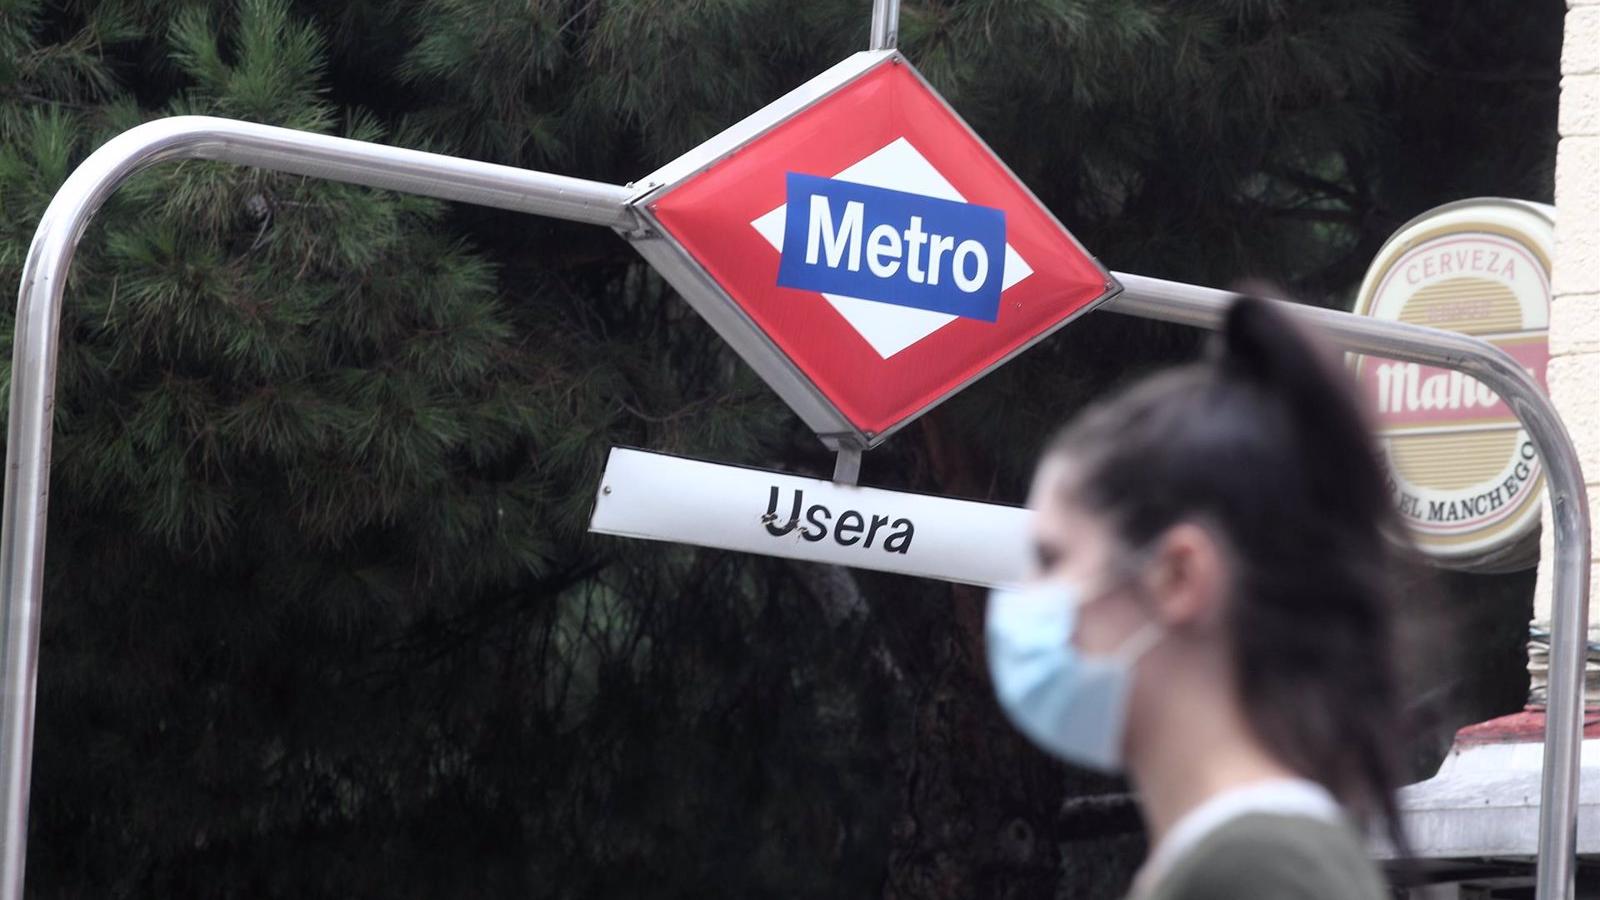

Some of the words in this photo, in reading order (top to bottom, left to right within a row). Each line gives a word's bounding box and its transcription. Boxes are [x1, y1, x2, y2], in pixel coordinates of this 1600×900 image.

[805, 194, 988, 293] Metro
[1407, 249, 1515, 285] CERVEZA
[1376, 362, 1535, 413] Maho
[1400, 492, 1423, 519] EL
[1427, 442, 1536, 521] MANCHEGO
[762, 486, 915, 554] Usera
